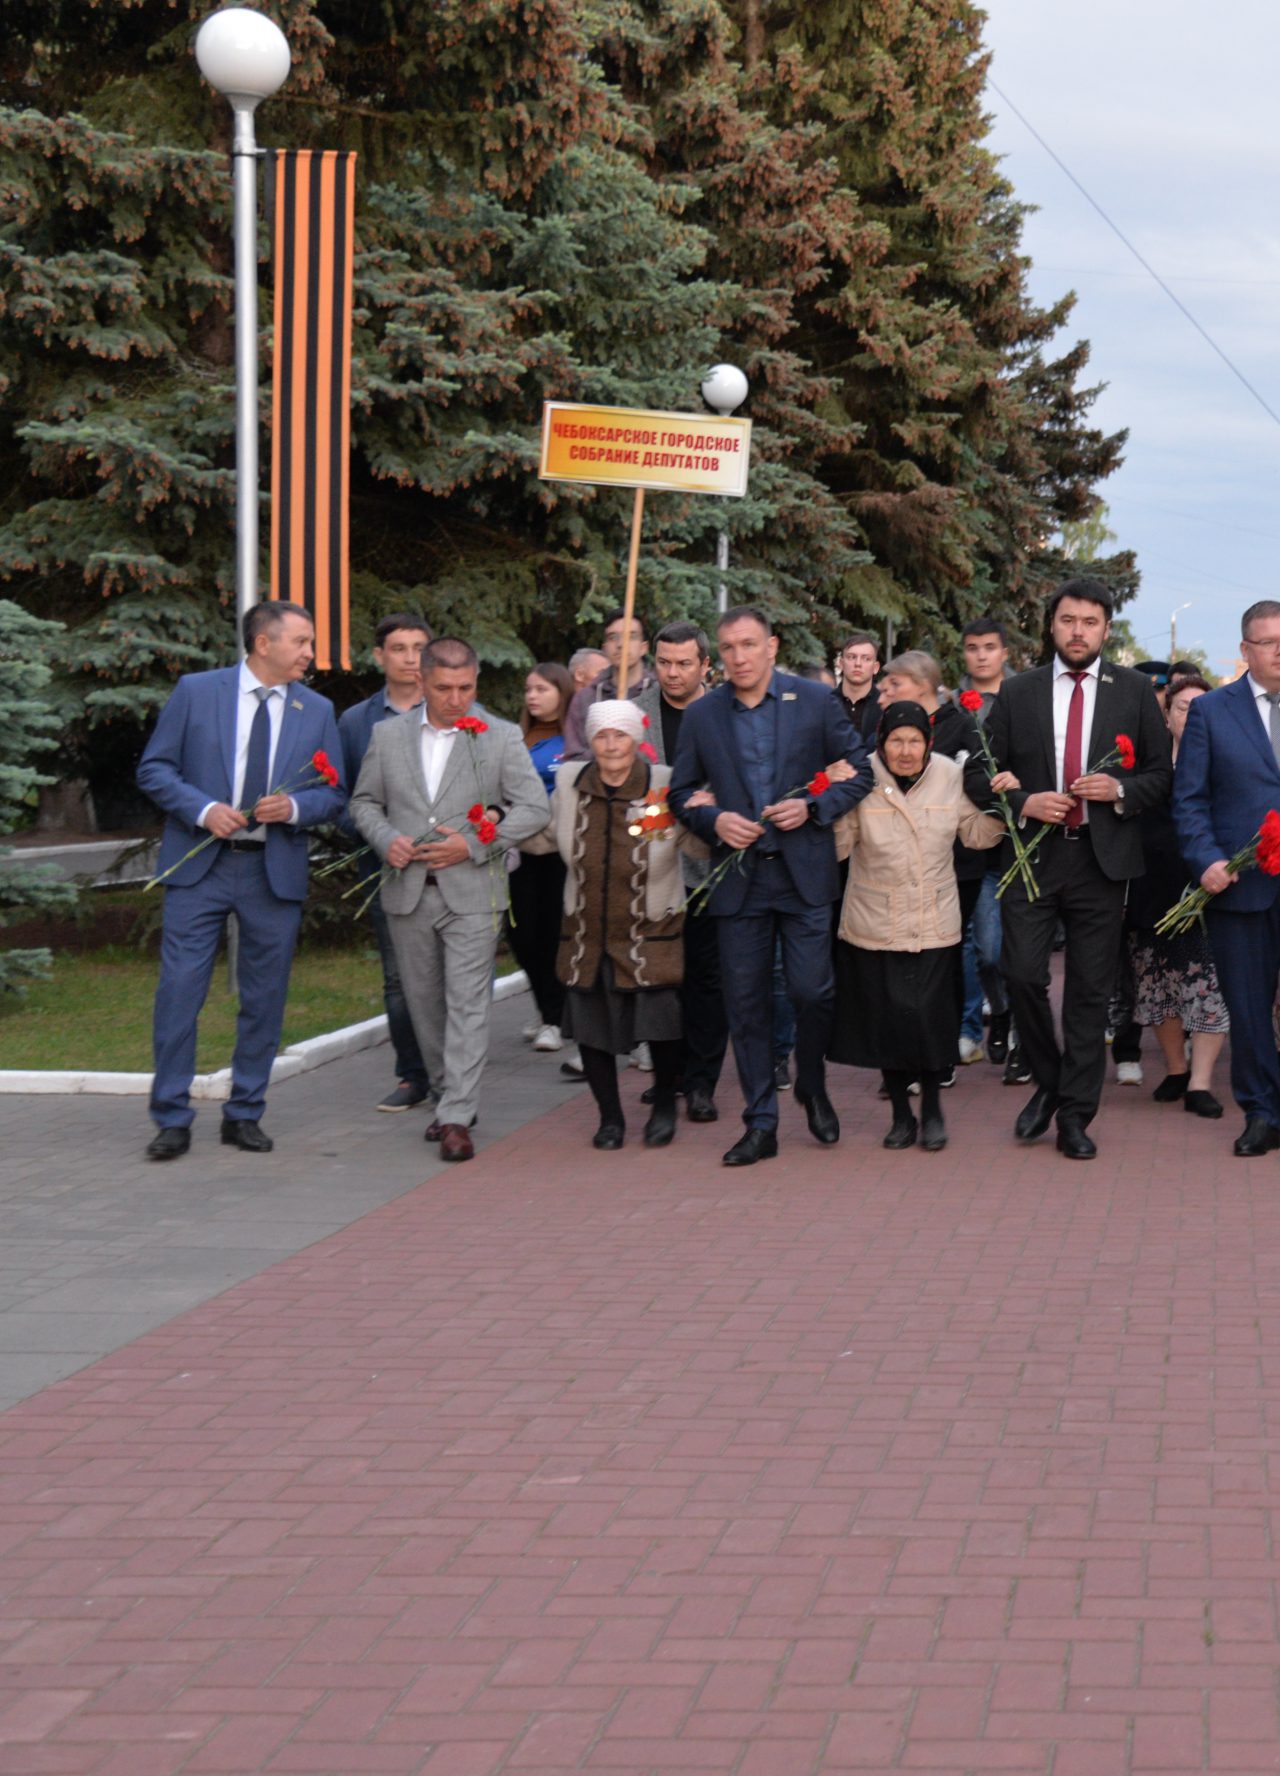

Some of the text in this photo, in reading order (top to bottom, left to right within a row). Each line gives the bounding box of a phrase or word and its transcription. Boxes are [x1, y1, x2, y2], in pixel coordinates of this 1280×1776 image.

[553, 422, 740, 453] ЧЕБОКСАРСКОЕ ГОРОДСКОЕ
[569, 445, 720, 472] СОБРАНИЕ ДЕПУТАТОВ
